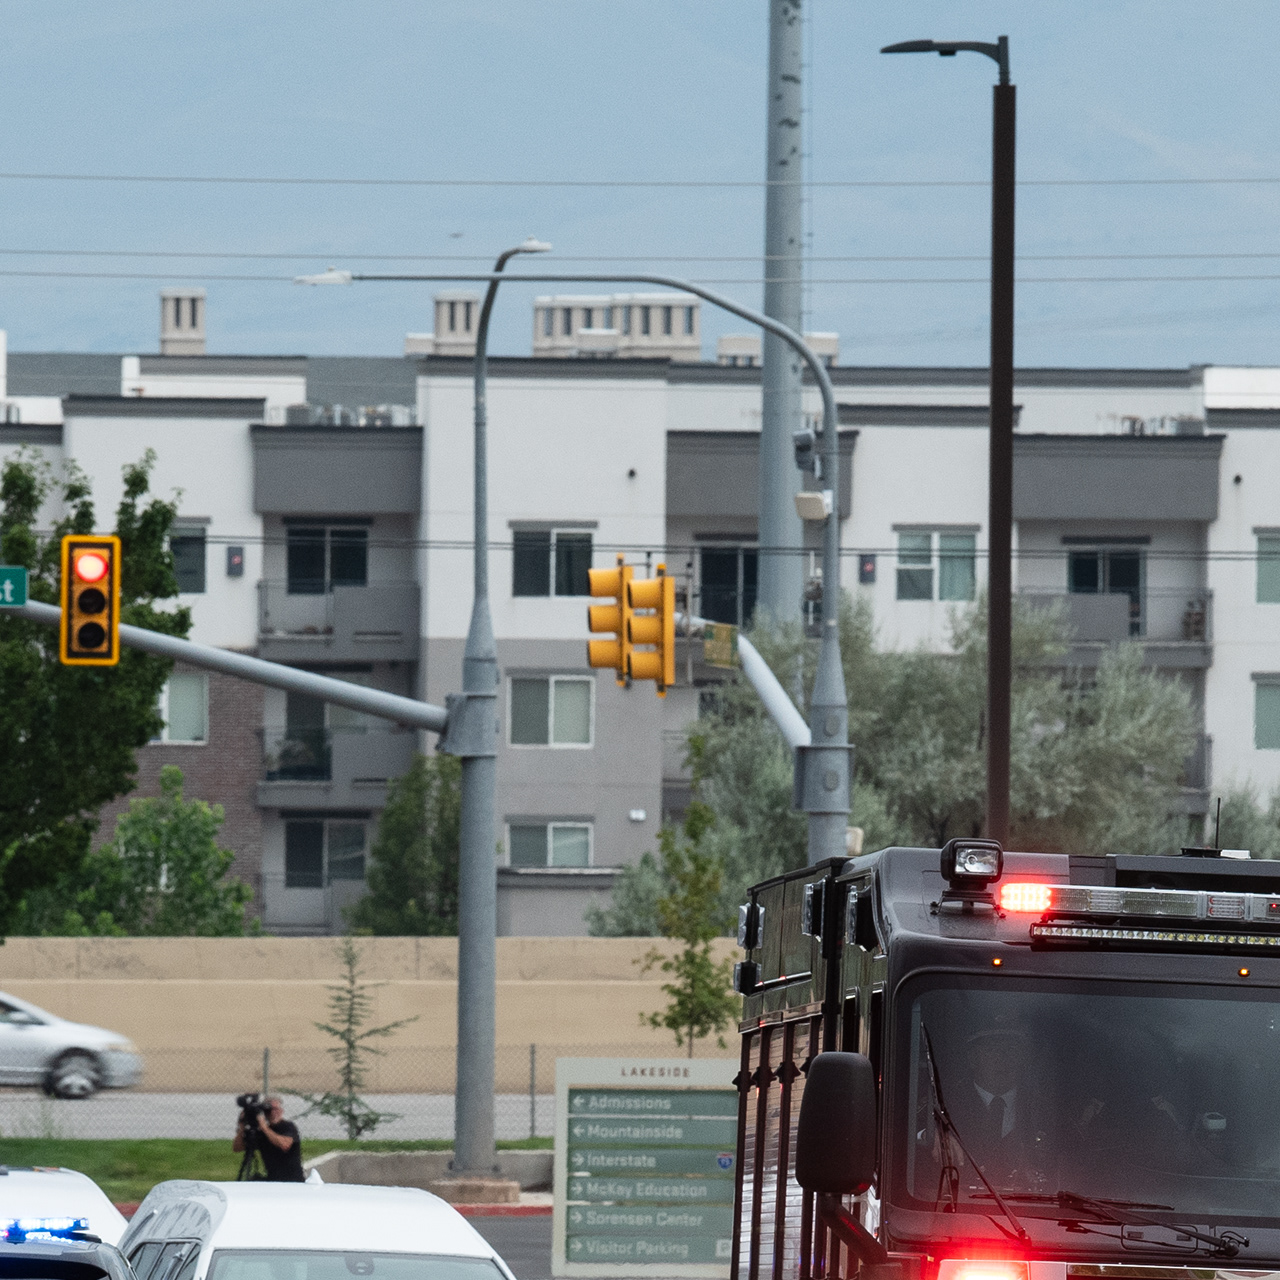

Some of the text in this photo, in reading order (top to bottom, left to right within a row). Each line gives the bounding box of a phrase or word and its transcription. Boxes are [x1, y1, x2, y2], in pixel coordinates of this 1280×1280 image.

[620, 1066, 691, 1078] LAKESIDE
[588, 1095, 672, 1109] Admissions
[587, 1124, 684, 1139] Mountainside
[587, 1153, 657, 1168] Interstate
[586, 1182, 707, 1198] McKay Education
[586, 1211, 704, 1227] Sorensen Center
[636, 1240, 689, 1259] Parking
